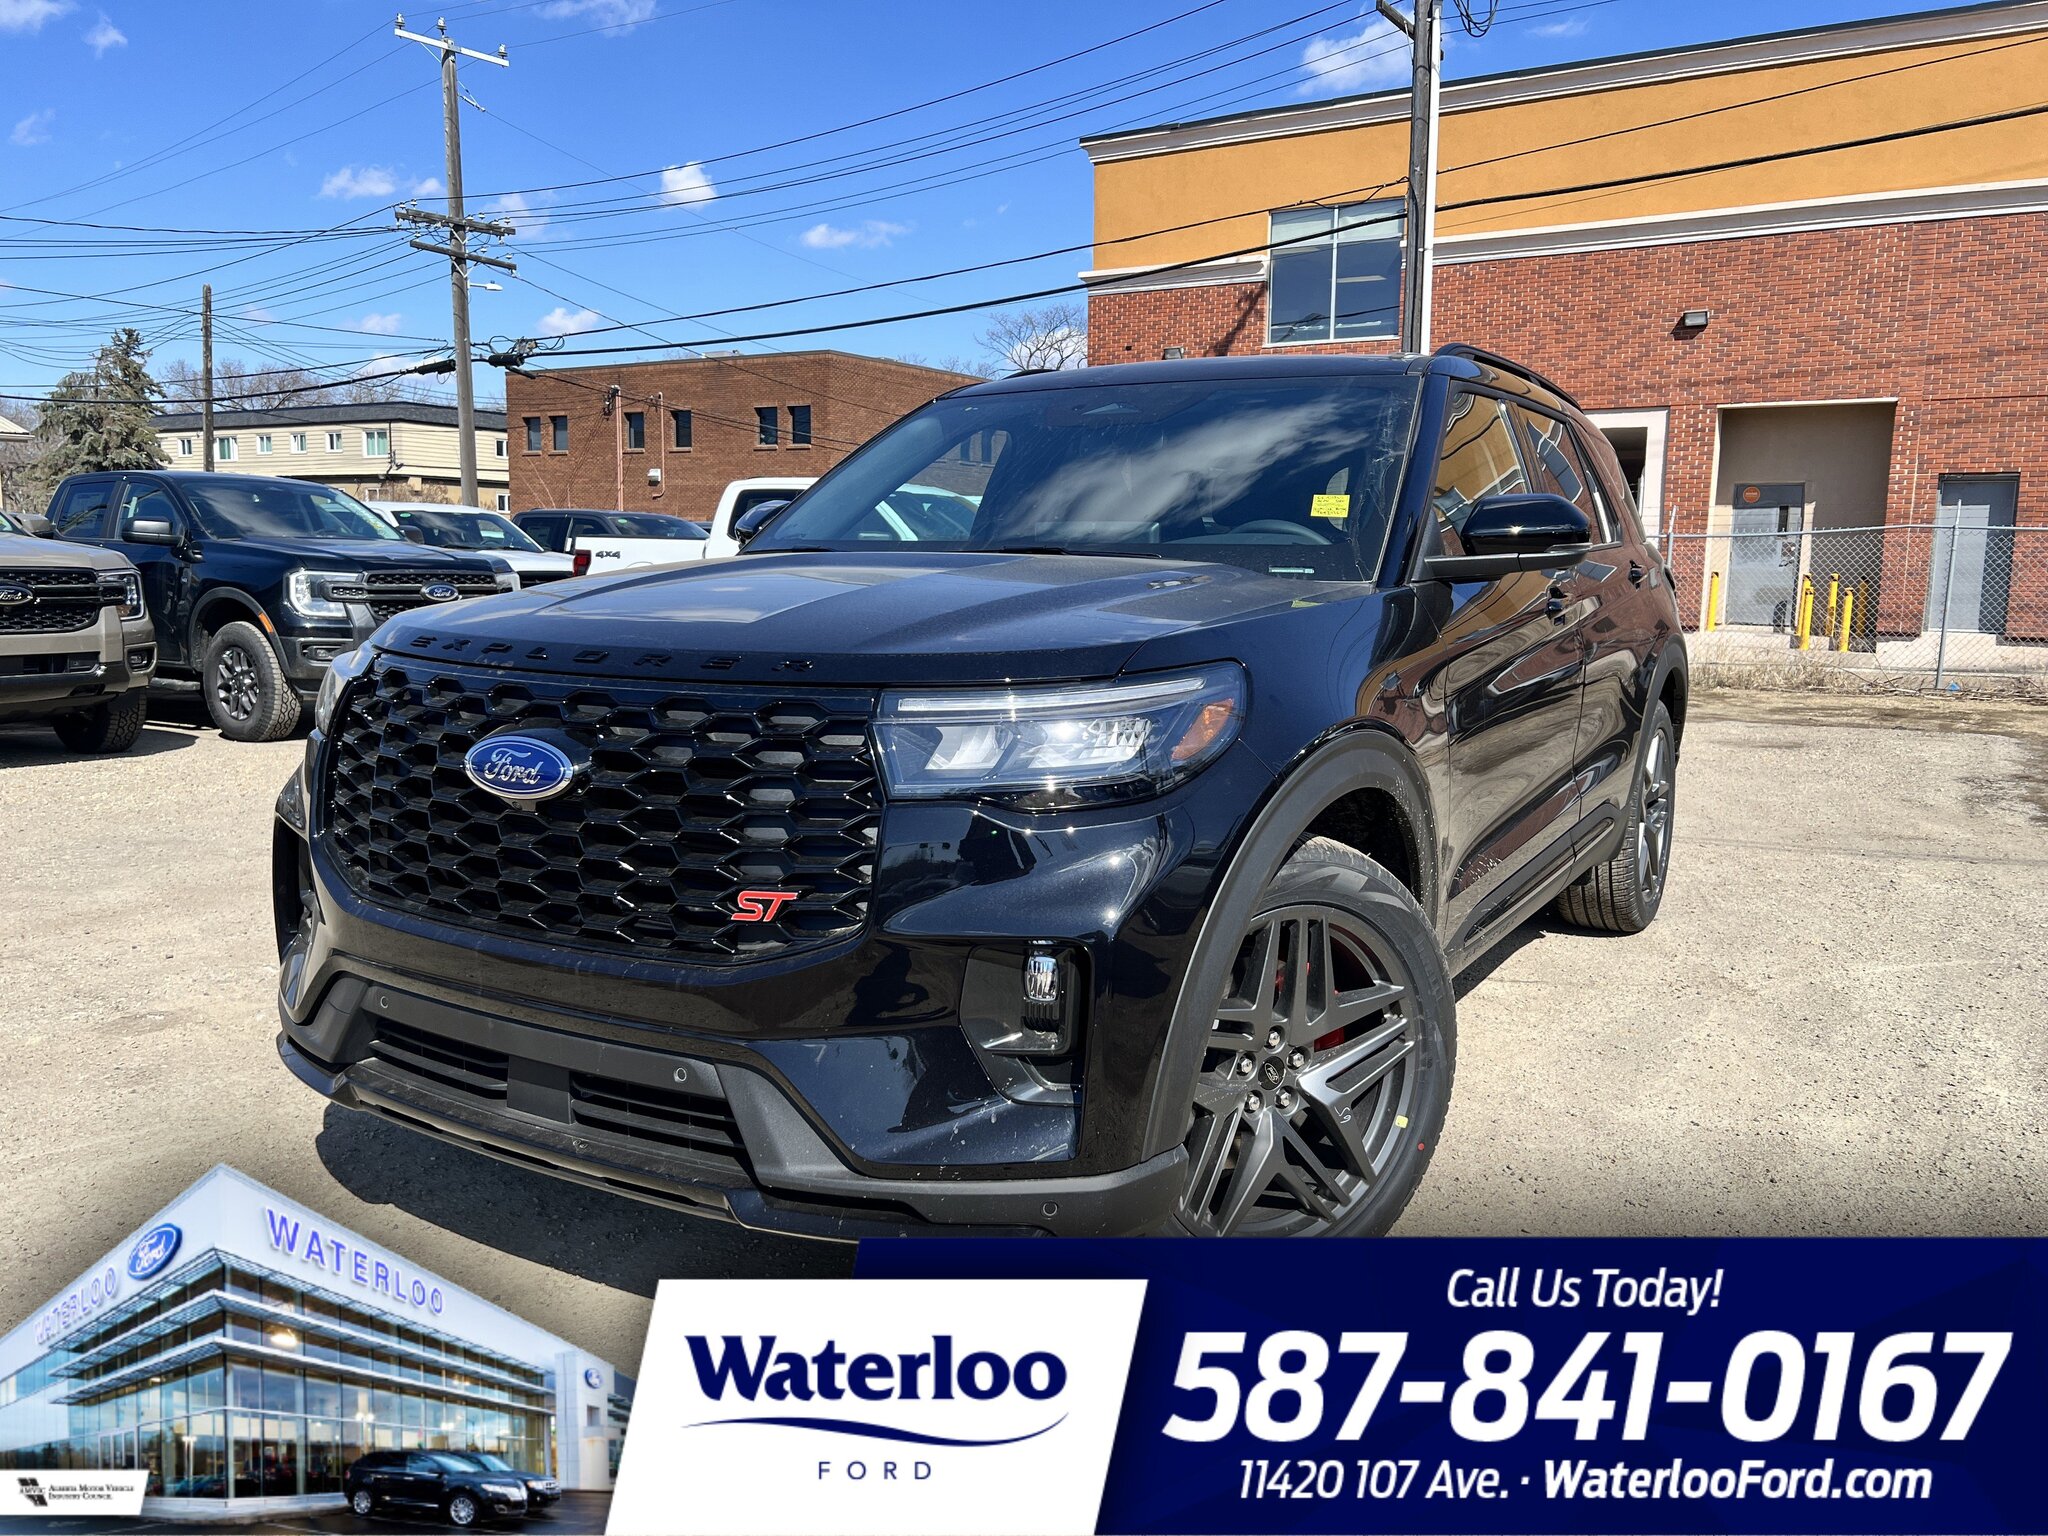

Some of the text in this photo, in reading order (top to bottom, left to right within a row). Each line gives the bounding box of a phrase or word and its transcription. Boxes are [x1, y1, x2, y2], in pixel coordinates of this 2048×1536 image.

[409, 633, 814, 673] EXPLORER
[484, 747, 544, 785] Ford
[730, 890, 798, 922] ST
